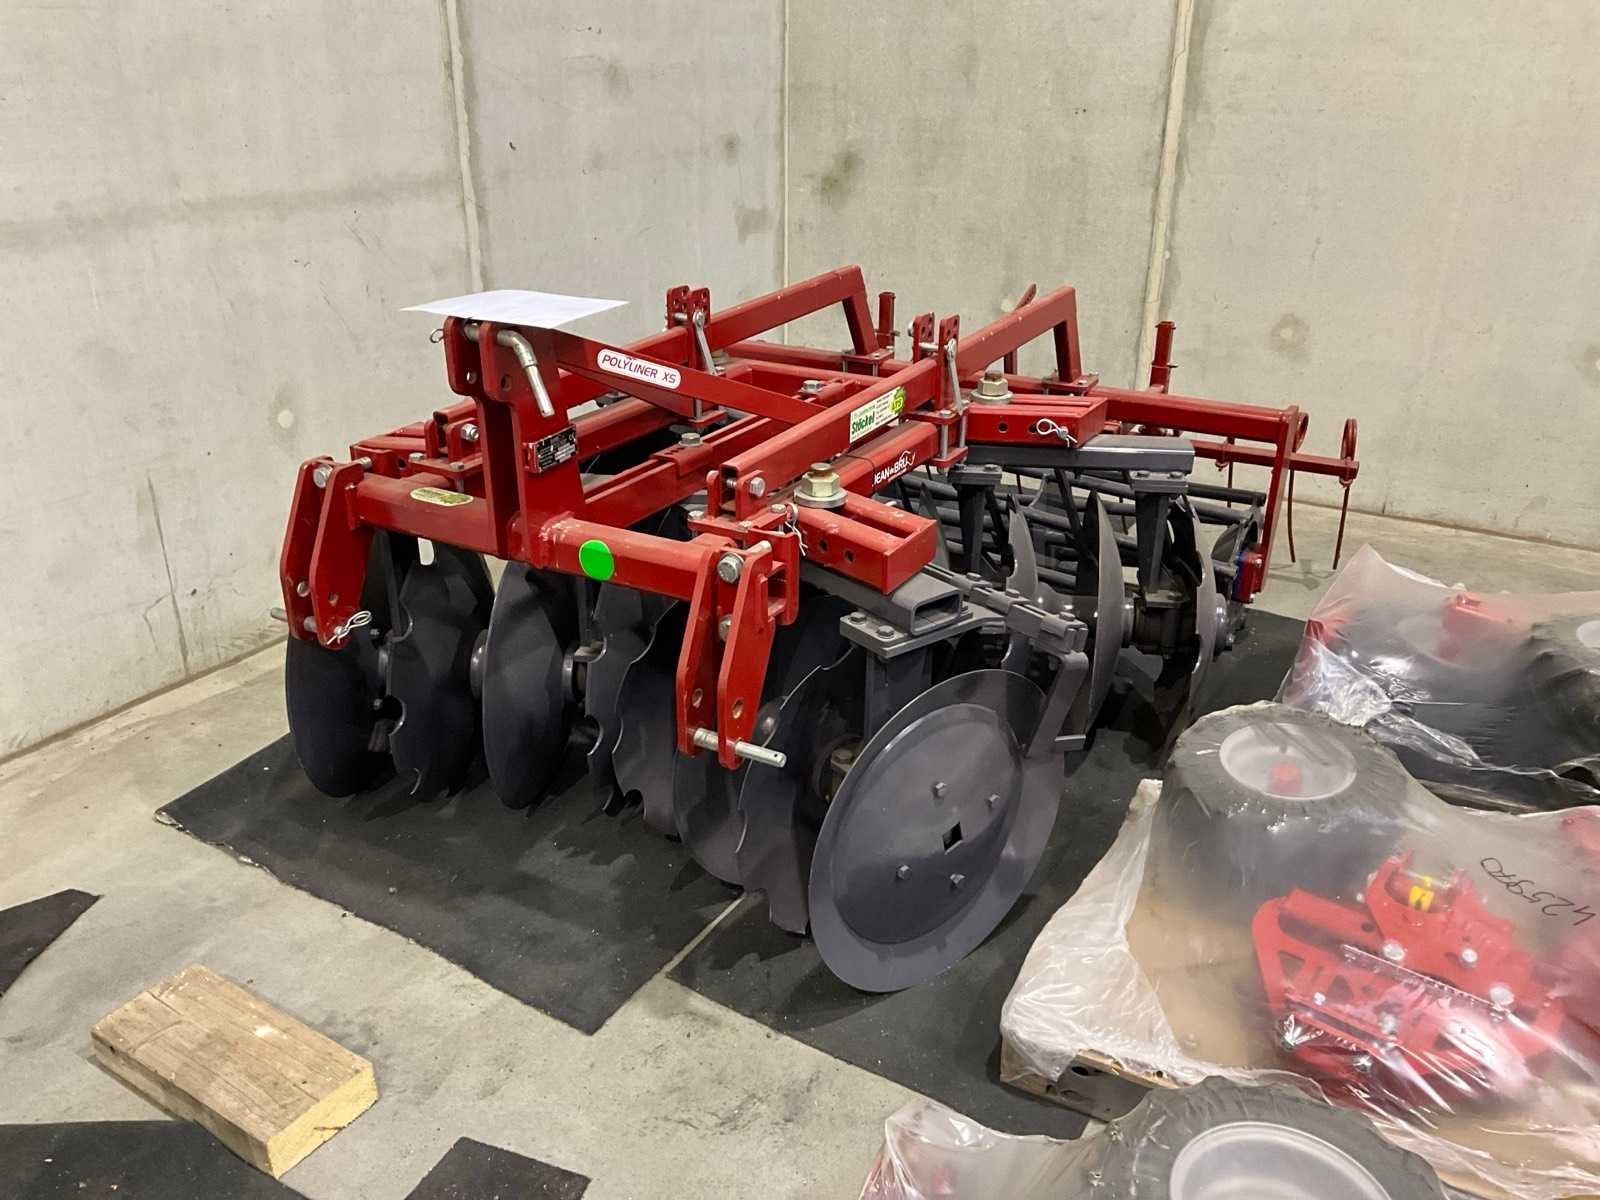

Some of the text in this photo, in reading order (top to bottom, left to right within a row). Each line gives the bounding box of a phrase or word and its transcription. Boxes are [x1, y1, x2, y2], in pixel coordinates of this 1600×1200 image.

[602, 354, 677, 384] POLYLINER XS
[872, 466, 890, 487] JEAN
